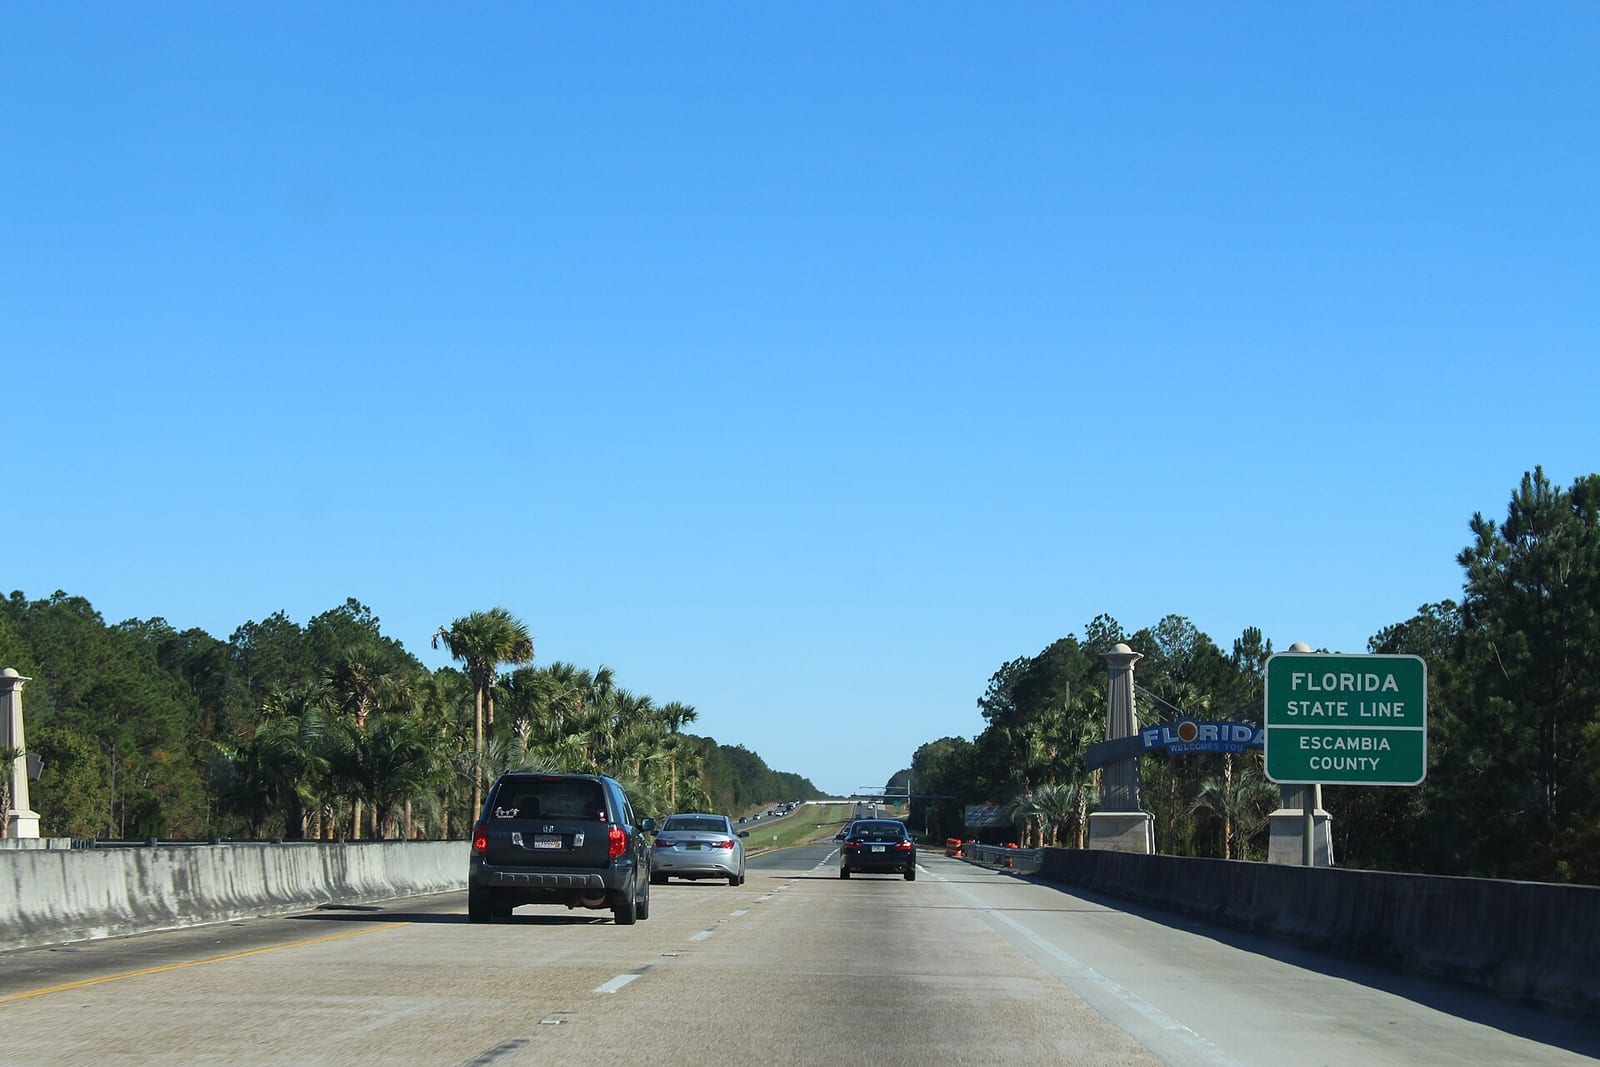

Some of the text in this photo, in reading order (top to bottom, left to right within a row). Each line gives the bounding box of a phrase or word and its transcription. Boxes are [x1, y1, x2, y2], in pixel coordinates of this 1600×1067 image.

[1292, 672, 1399, 692] FLORIDA
[1287, 701, 1405, 718] STATE LINE
[1171, 742, 1243, 752] WELCOMES YOU
[1299, 736, 1391, 751] ESCAMBIA
[1309, 756, 1381, 771] COUNTY
